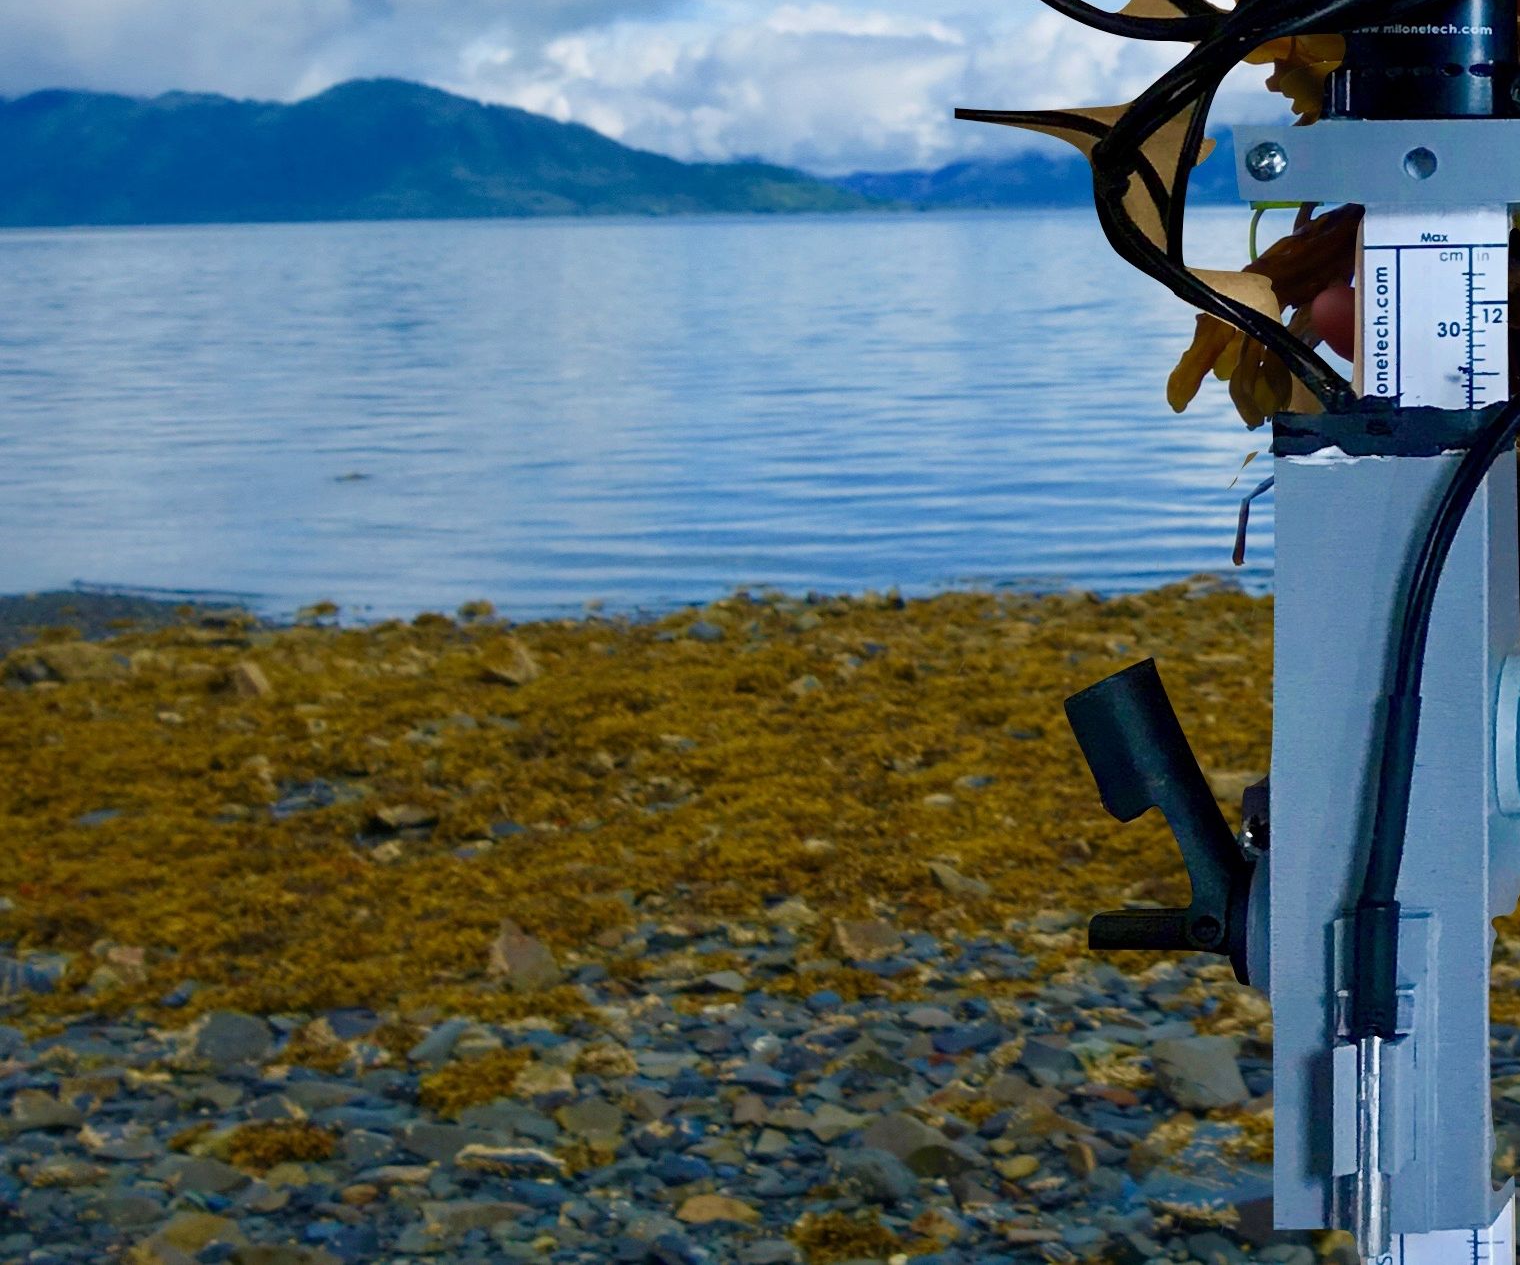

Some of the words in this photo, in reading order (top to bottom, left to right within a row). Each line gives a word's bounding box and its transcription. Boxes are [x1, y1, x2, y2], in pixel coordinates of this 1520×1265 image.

[1420, 232, 1449, 243] Max
[1439, 251, 1463, 262] cm
[1476, 251, 1490, 262] in
[1482, 308, 1503, 324] 12
[1437, 321, 1461, 338] 30
